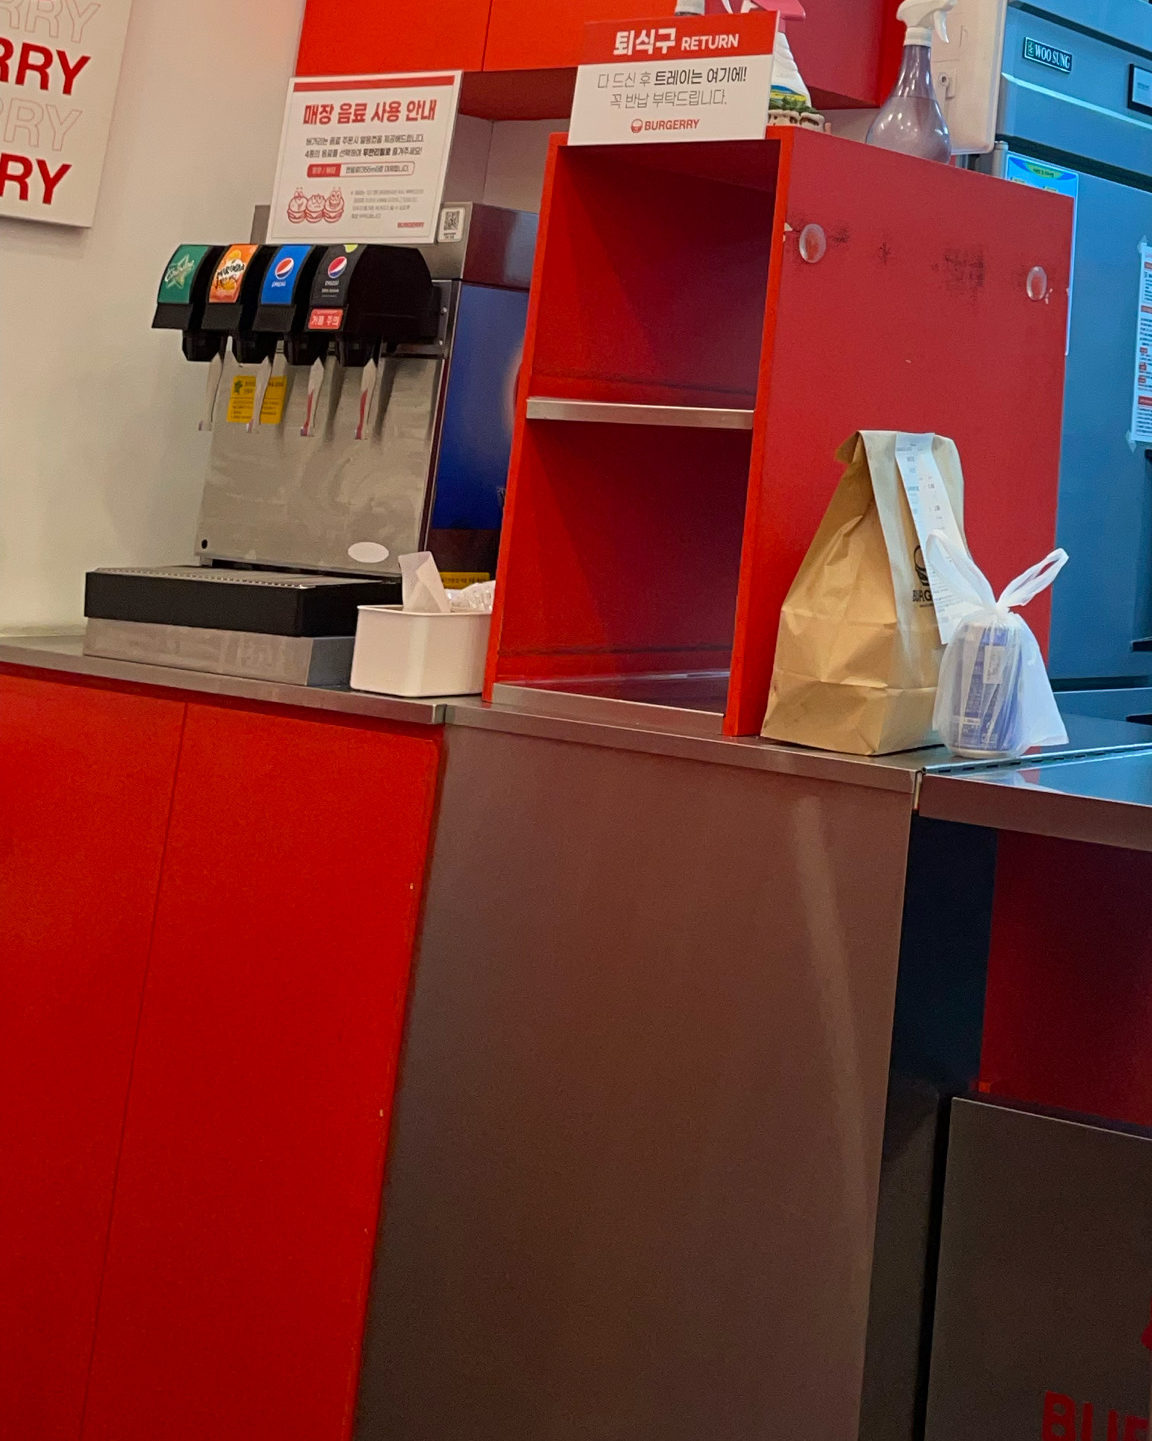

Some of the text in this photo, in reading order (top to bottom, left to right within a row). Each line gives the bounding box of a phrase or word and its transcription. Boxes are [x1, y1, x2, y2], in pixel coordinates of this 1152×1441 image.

[613, 27, 739, 56] 퇴식구 RETURN
[1035, 44, 1070, 68] WOO SUNG
[598, 66, 747, 89] 다 드신 후 트레이는 여기에!
[610, 89, 727, 108] 꼭 반납 부탁드립니다.
[303, 99, 437, 125] 매장 음료 사용 안내
[645, 119, 700, 131] BURGERRY
